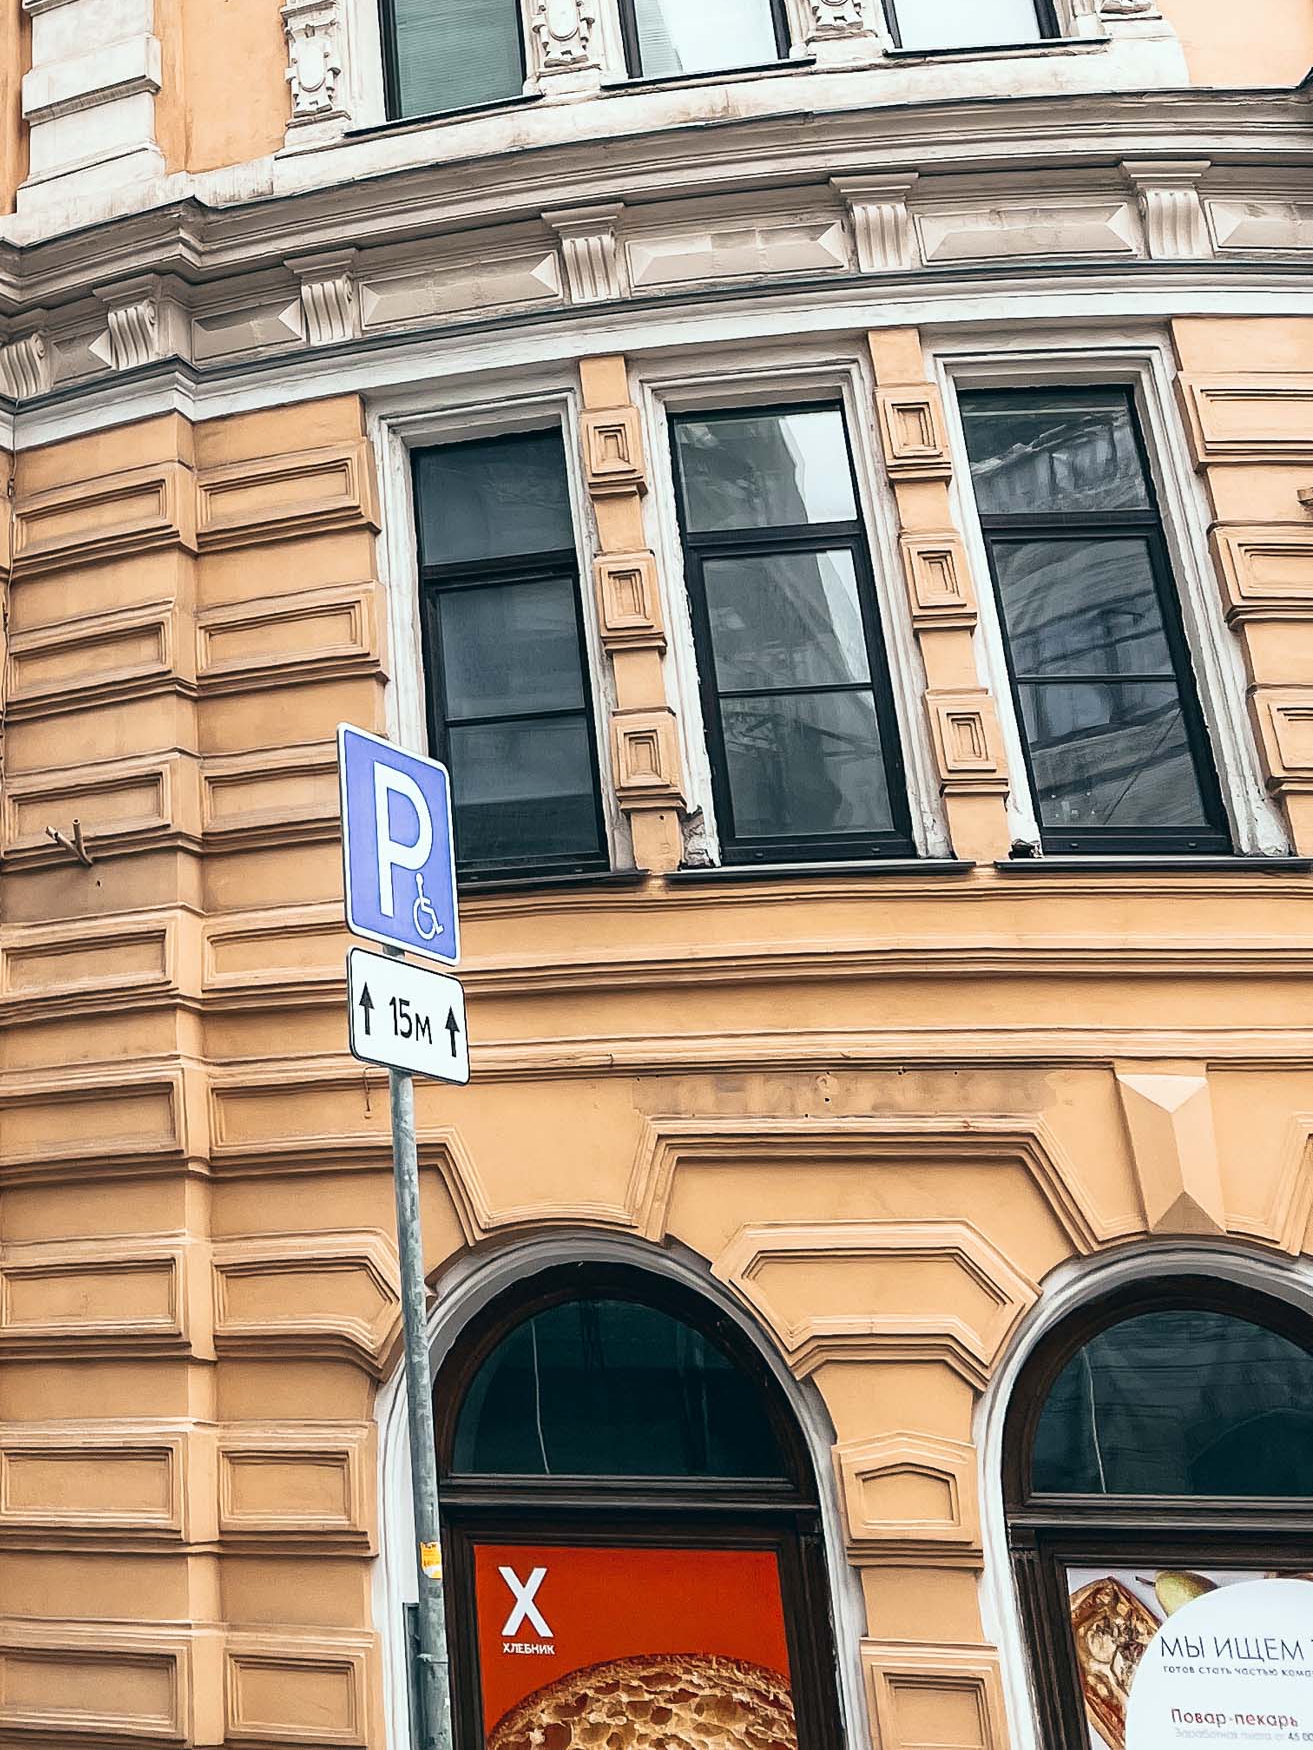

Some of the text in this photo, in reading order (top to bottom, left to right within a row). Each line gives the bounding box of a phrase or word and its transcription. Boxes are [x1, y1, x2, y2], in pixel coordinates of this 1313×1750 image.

[373, 761, 433, 918] P
[502, 1642, 556, 1655] ХЛЕБНИК
[1160, 1636, 1205, 1658] МЫ
[1213, 1636, 1305, 1662] ИЩЕМ
[1281, 1668, 1313, 1678] кома
